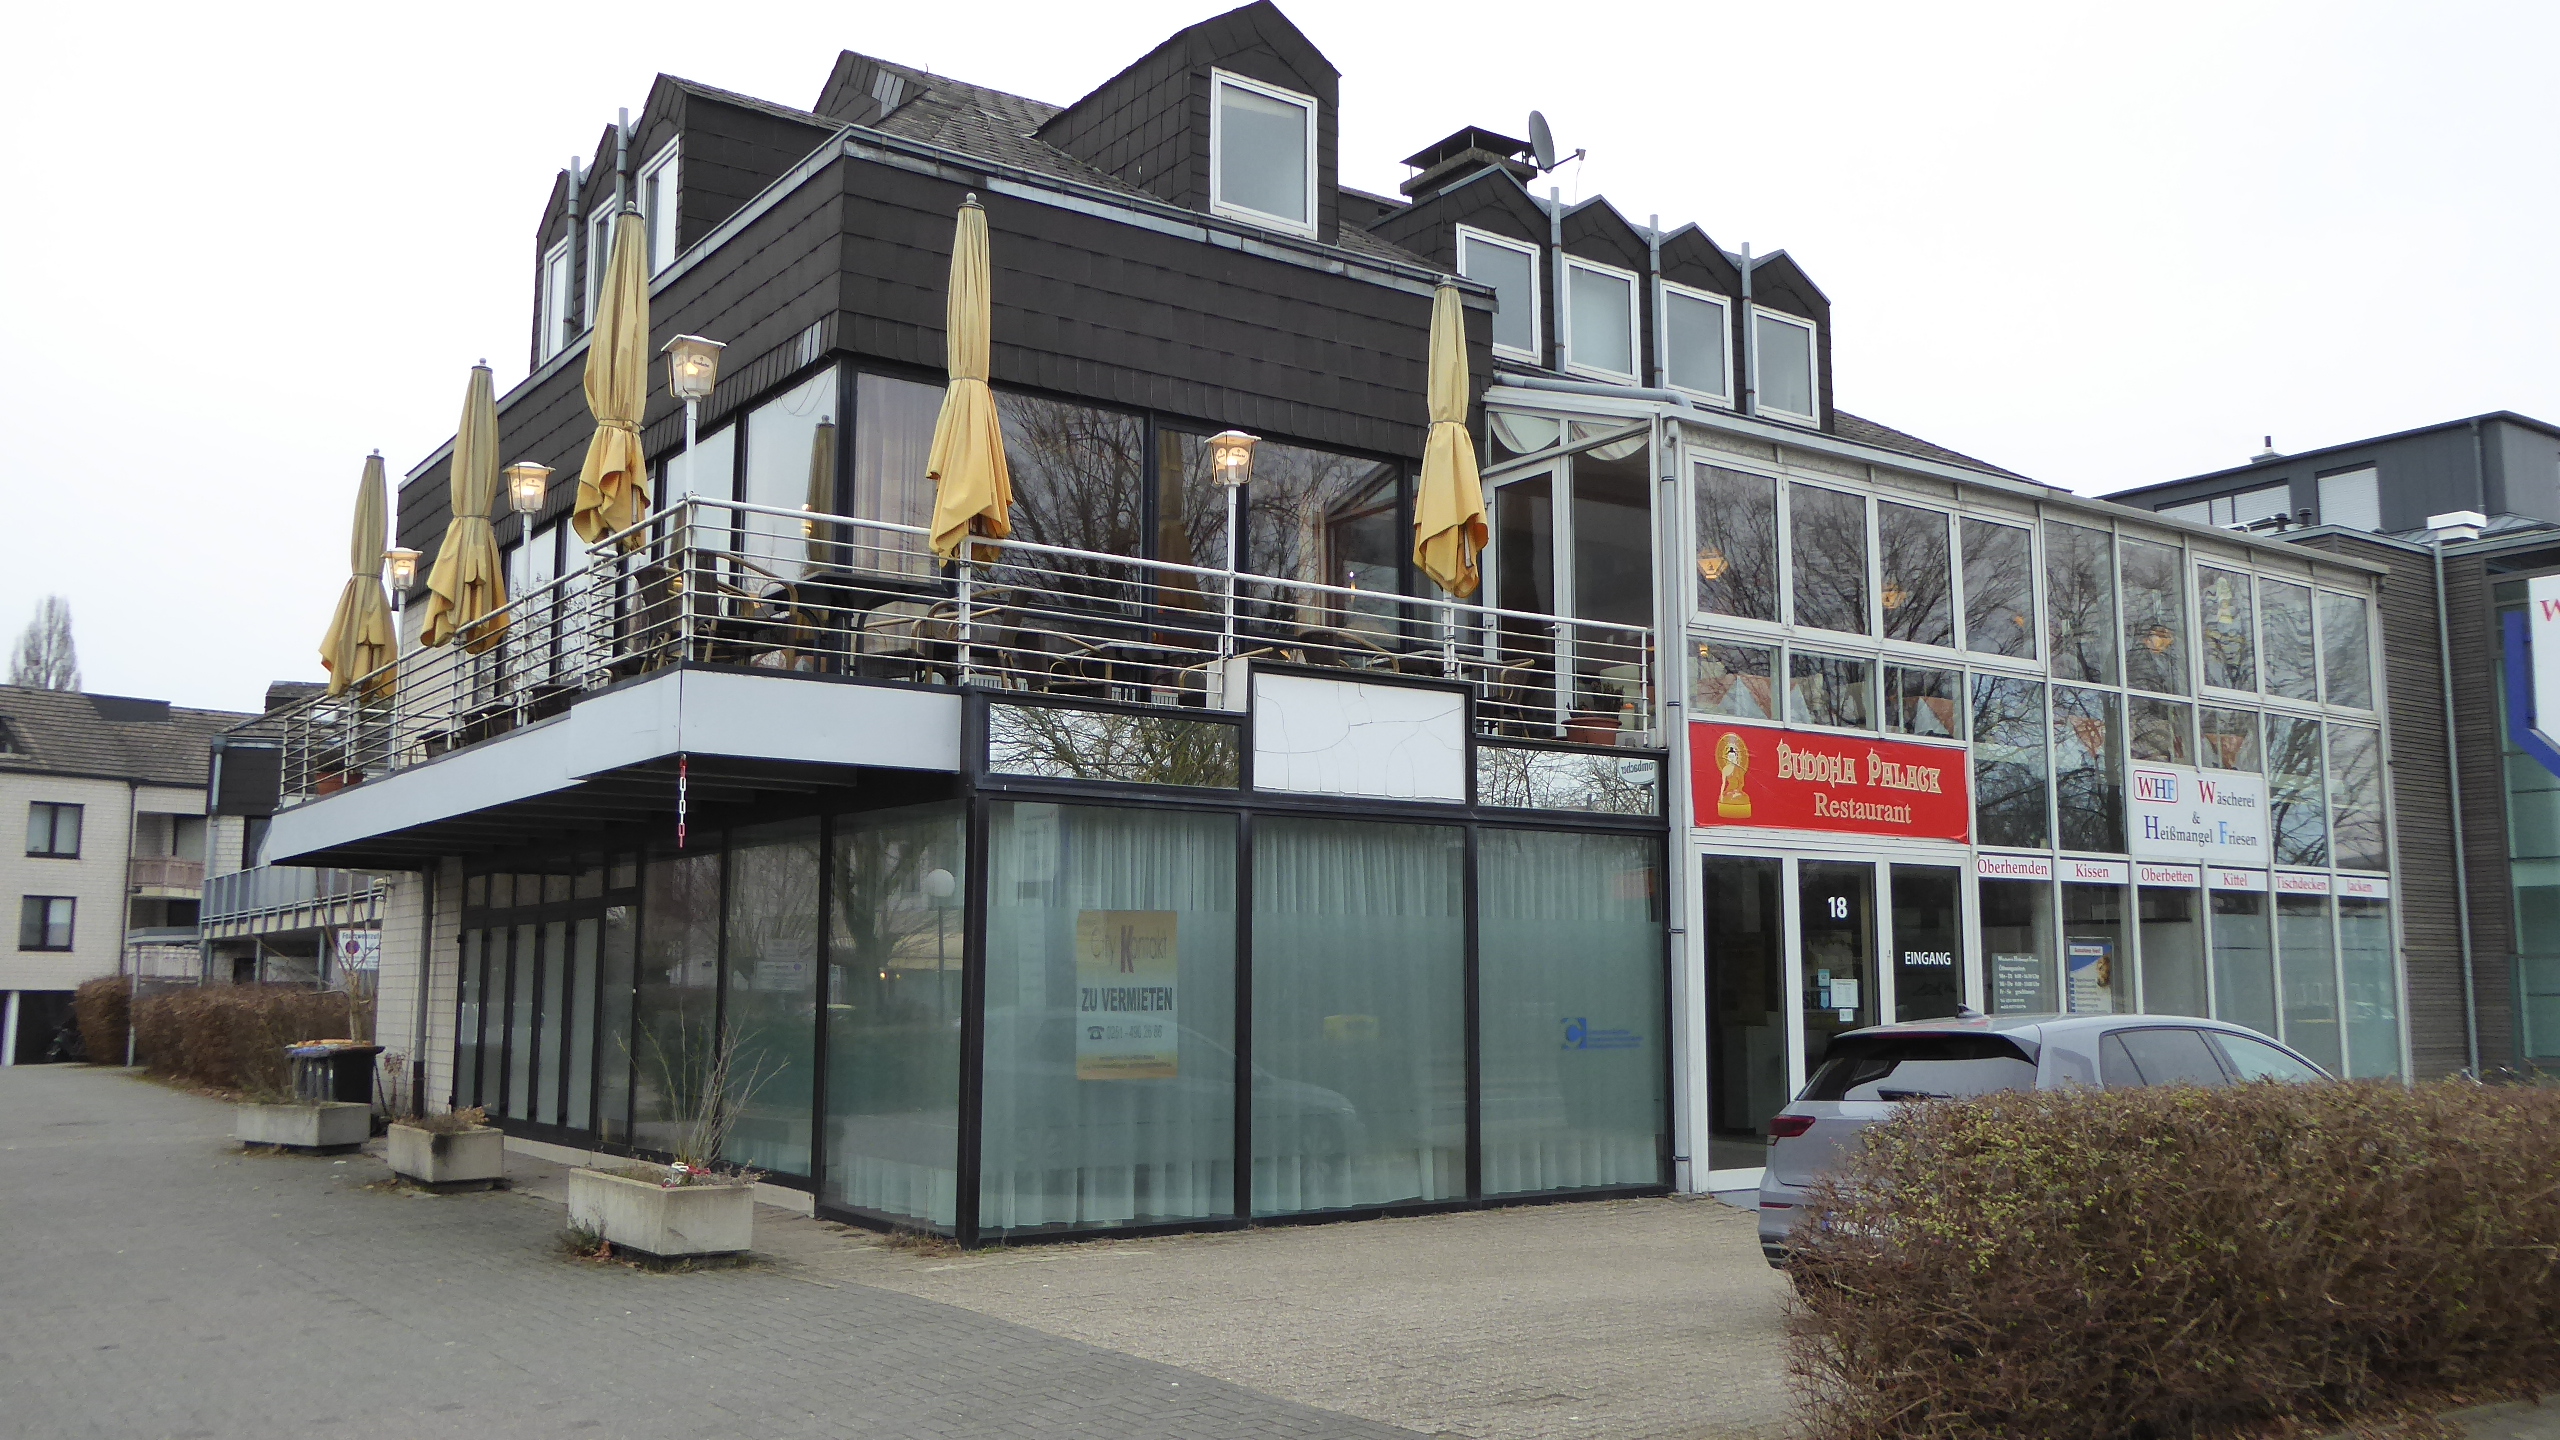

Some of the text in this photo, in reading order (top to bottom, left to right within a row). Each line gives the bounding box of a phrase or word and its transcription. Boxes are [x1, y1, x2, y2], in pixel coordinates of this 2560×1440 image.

[1776, 738, 1942, 794] BUDDHA PALACE
[2137, 776, 2175, 800] WHF
[2197, 779, 2256, 808] Wäscherei
[1813, 792, 1912, 824] Restaurant
[2191, 811, 2200, 825] &
[2143, 815, 2258, 847] Heißmangel Friesen
[1977, 858, 2048, 876] Oberhemden
[2075, 863, 2109, 878] Kissen
[2141, 867, 2194, 883] Oberbetten
[2222, 872, 2248, 887] Kittel
[2275, 875, 2327, 891] Tischdecken
[2346, 879, 2373, 893] Jacken
[1827, 896, 1848, 919] 18
[1904, 951, 1951, 966] EINGANG
[1081, 986, 1173, 1012] ZU VERMIETEN
